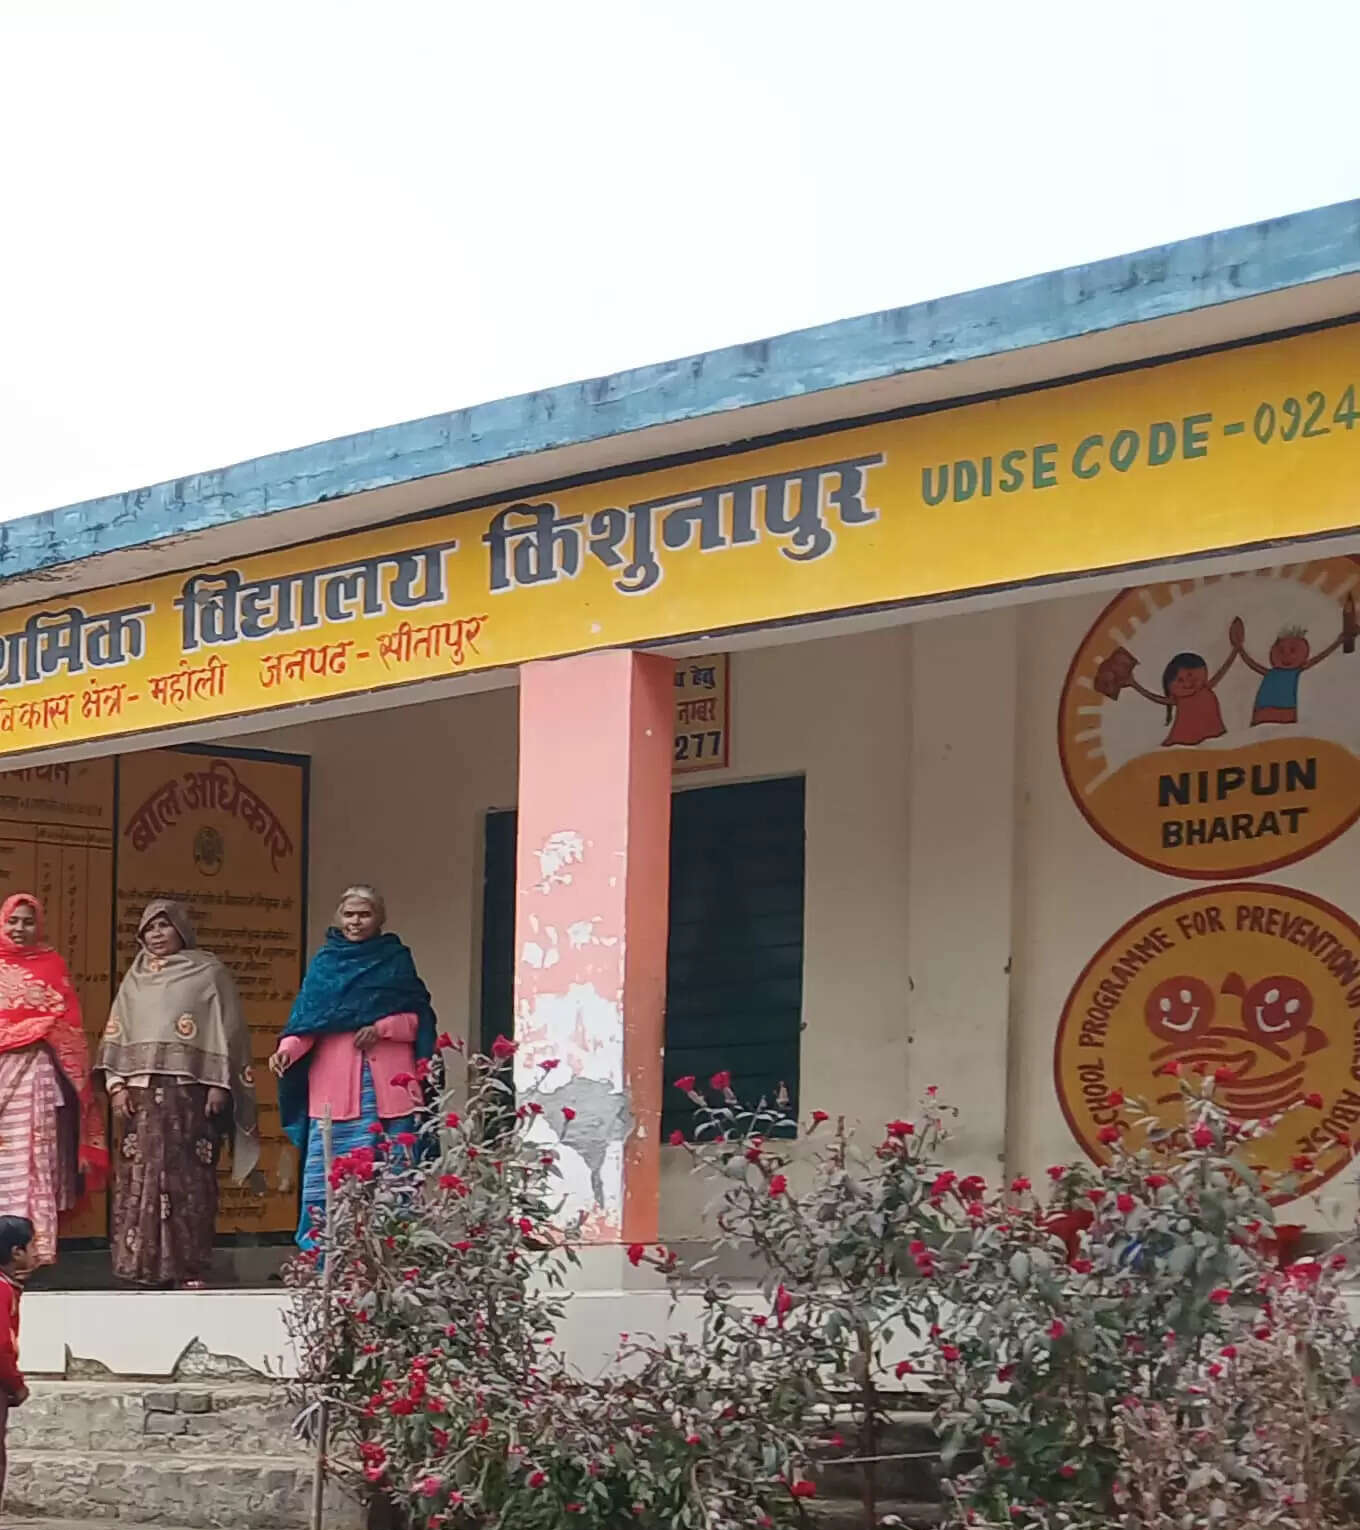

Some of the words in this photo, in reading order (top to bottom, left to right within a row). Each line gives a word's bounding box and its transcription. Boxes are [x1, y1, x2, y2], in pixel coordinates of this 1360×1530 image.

[921, 443, 1059, 506] UDISE
[1071, 412, 1214, 480] CODE
[173, 539, 460, 653] विद्यालय
[482, 451, 888, 596] किशुनापुर
[148, 654, 229, 713] महोली
[376, 614, 490, 671] सीतापुर
[674, 730, 722, 761] 277
[1157, 757, 1317, 808] NIPUN
[123, 779, 182, 853] बाल
[182, 758, 294, 874] अधिकार
[1161, 806, 1309, 850] BHARAT
[1077, 926, 1176, 1049] PROGRAMME
[1175, 904, 1227, 942] FOR
[1235, 904, 1360, 987] PREVENTION
